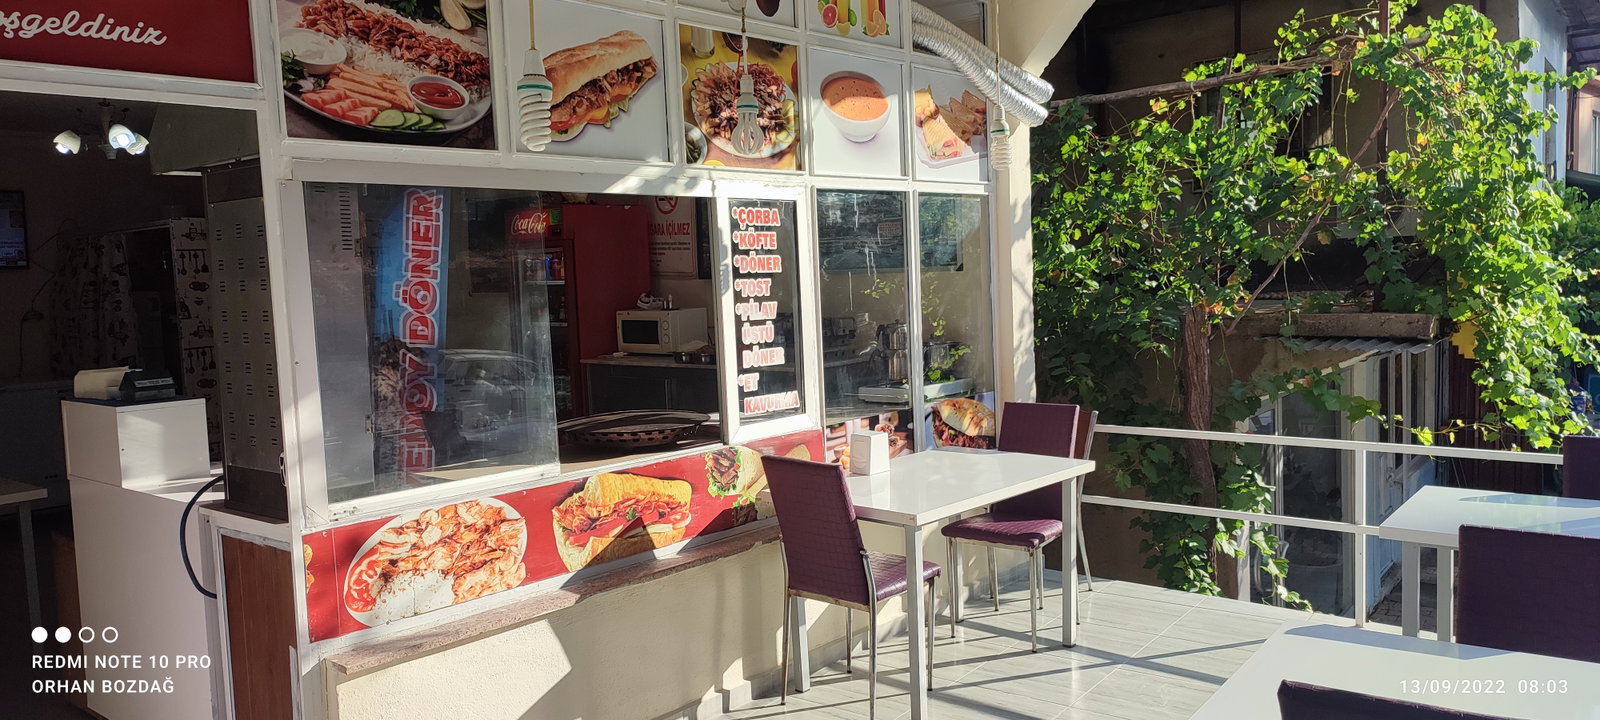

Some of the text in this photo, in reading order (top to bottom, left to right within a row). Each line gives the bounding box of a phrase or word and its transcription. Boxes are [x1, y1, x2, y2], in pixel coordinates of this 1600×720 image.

[393, 187, 443, 348] DÖNER
[741, 320, 775, 345] ÜSTÜ
[742, 345, 786, 369] DÖNER
